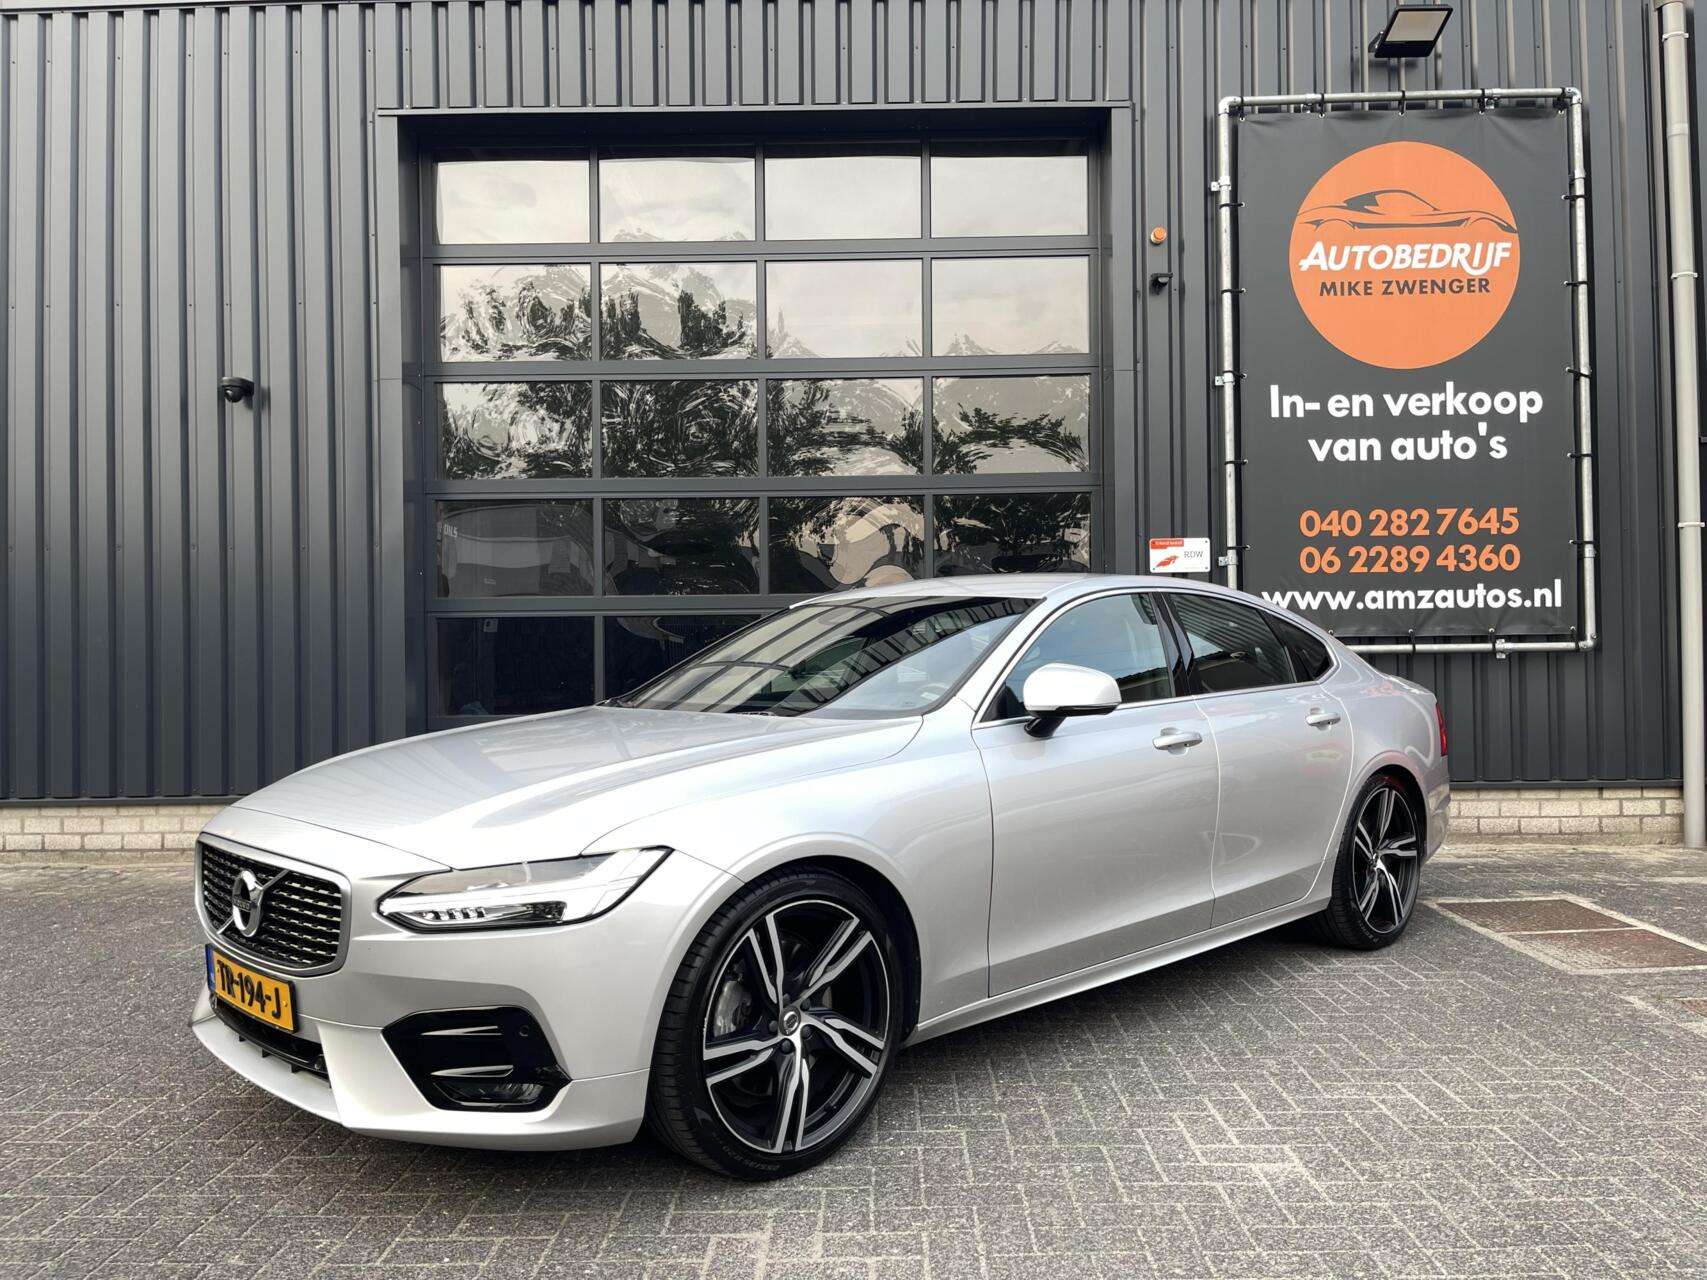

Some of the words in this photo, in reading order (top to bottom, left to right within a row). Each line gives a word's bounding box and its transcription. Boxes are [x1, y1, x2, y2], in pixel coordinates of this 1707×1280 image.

[1299, 241, 1512, 275] AUTOBEDRIJF
[1319, 281, 1373, 297] MIKE
[1382, 278, 1491, 295] ZWENGER
[1270, 384, 1321, 418] In-
[1327, 393, 1374, 417] en
[1383, 381, 1543, 423] verkoop
[1308, 438, 1381, 462] van
[1391, 421, 1508, 461] auto's
[1299, 509, 1362, 537] 040
[1369, 508, 1430, 536] 282
[1436, 507, 1520, 535] 7645
[1299, 546, 1342, 574] 06
[1349, 545, 1430, 573] 2289
[1436, 543, 1521, 572] 4360
[1261, 579, 1562, 610] www.amzautos.nl
